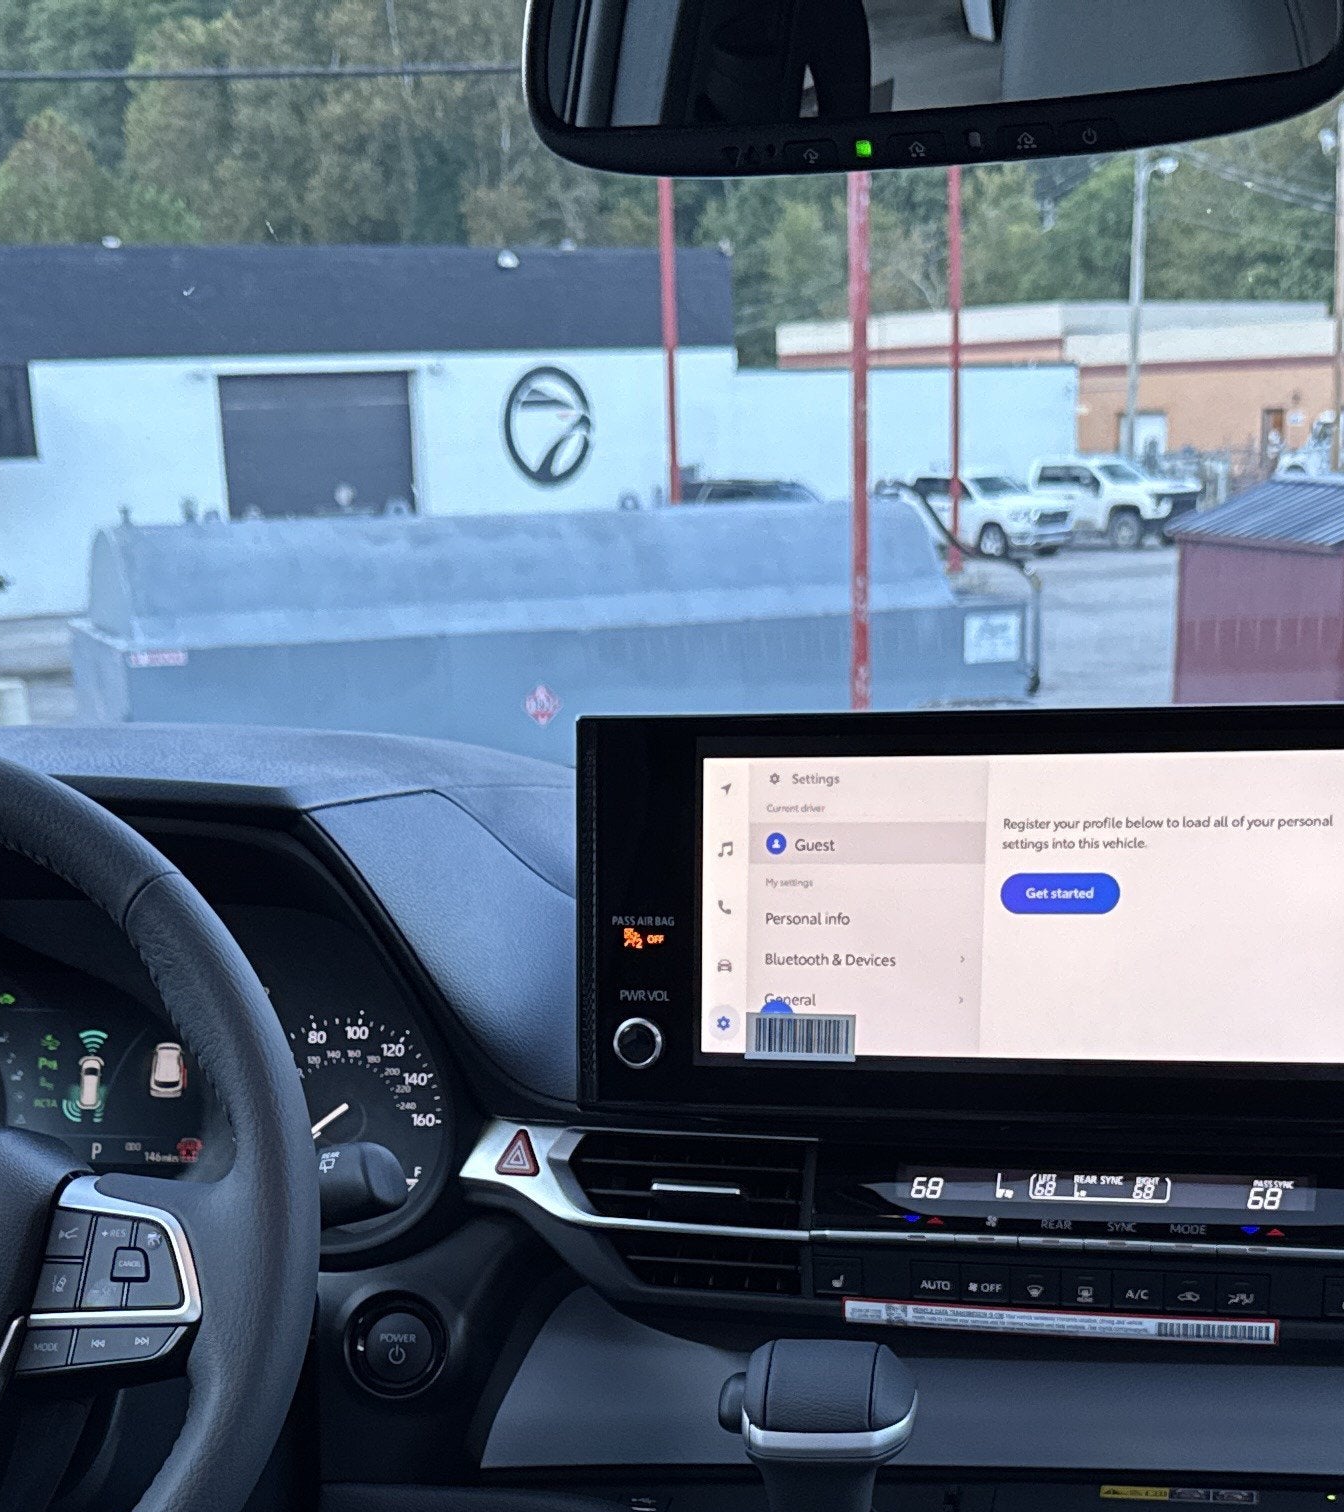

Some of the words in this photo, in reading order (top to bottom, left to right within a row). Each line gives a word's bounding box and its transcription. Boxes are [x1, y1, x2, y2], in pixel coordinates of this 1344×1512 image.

[792, 773, 840, 787] Settings
[766, 804, 799, 813] Current
[801, 803, 826, 813] driver
[1003, 818, 1051, 832] Register
[1053, 820, 1080, 832] your
[1083, 817, 1123, 831] profile
[1125, 816, 1163, 828] below
[1166, 818, 1180, 828] to
[1183, 816, 1211, 828] load
[1213, 816, 1228, 828] all
[1231, 816, 1245, 828] of
[1246, 818, 1275, 830] your
[1278, 815, 1333, 830] personal
[795, 838, 835, 852] Guest
[1002, 838, 1049, 852] settings
[1052, 838, 1076, 849] into
[1078, 837, 1100, 849] this
[1102, 837, 1148, 849] vehicle.
[766, 878, 778, 889] My
[1025, 887, 1049, 899] Get
[1050, 887, 1095, 900] started
[612, 916, 635, 926] PASS
[637, 916, 653, 926] AIR
[655, 916, 675, 926] BAG
[765, 912, 822, 926] Personal
[825, 911, 851, 926] info
[646, 934, 665, 944] OFF
[765, 953, 829, 966] Bluetooth
[832, 953, 842, 966] &
[845, 953, 897, 967] Devices
[619, 990, 646, 1001] PWR
[647, 990, 670, 1001] VOL
[307, 1031, 327, 1044] 80
[345, 1026, 369, 1040] 100
[381, 1043, 405, 1057] 120
[384, 1068, 400, 1076] 200
[403, 1073, 428, 1086] 140
[411, 1113, 436, 1127] 160
[91, 1142, 102, 1160] P
[414, 1166, 422, 1177] F
[1038, 1174, 1057, 1182] LEFT
[1073, 1175, 1098, 1185] REAR
[1100, 1176, 1124, 1186] SYNC
[911, 1177, 944, 1199] 68
[1034, 1182, 1056, 1196] 68
[1274, 1180, 1294, 1190] SYNC
[1132, 1185, 1155, 1200] 68
[1247, 1187, 1283, 1211] 68
[1040, 1220, 1073, 1231] REAR
[1107, 1222, 1138, 1233] SYNC
[1169, 1224, 1206, 1235] MODE
[920, 1279, 951, 1291] AUTO
[981, 1282, 1002, 1293] OFF
[1125, 1289, 1149, 1300] A/C
[379, 1333, 416, 1343] POWER
